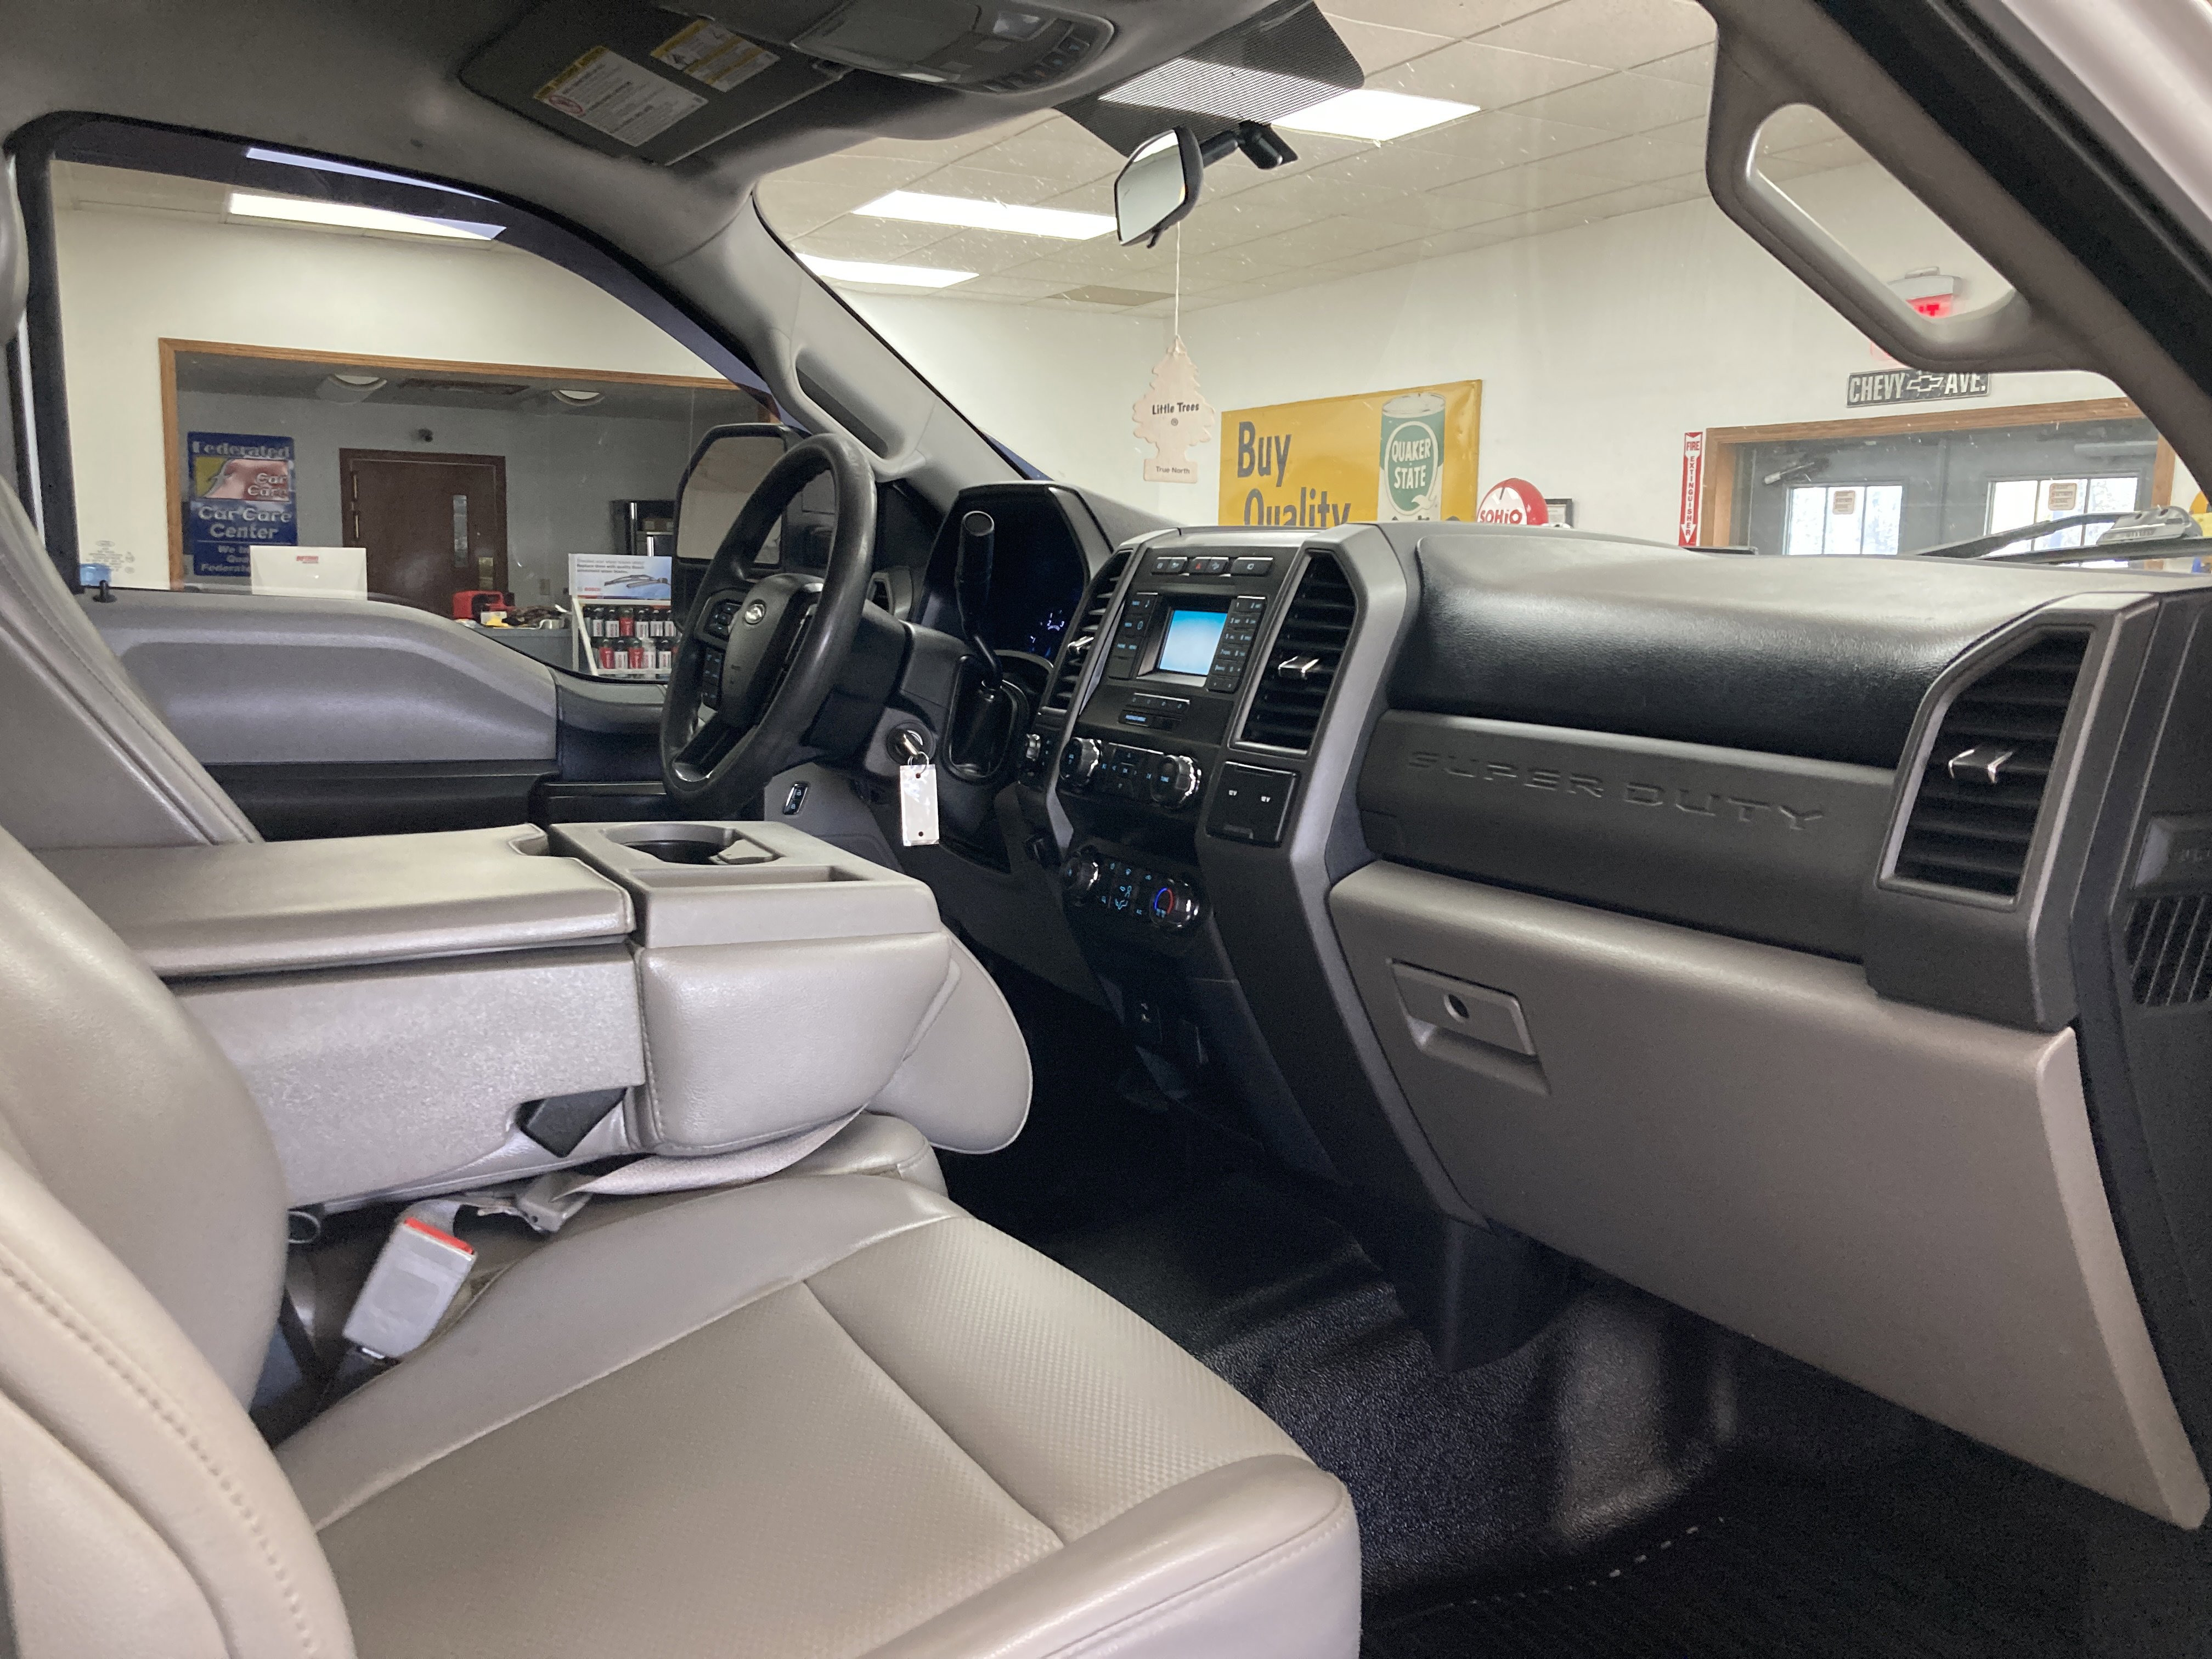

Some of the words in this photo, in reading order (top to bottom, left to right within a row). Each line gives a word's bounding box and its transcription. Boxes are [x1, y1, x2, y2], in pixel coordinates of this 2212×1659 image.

[1849, 373, 1905, 403] CHEVY
[1944, 373, 1986, 394] AVE.
[1152, 403, 1175, 415] Little
[1177, 402, 1200, 413] Trees
[192, 441, 290, 458] Federated
[1237, 421, 1292, 487] Buy
[1391, 438, 1431, 463] QUAKER
[1686, 441, 1700, 452] FIRE
[256, 473, 287, 486] Car
[1393, 465, 1426, 489] STATE
[247, 485, 287, 496] Care
[1685, 456, 1695, 536] EXTINGUISHER
[198, 506, 240, 521] Car
[242, 507, 293, 523] Care
[209, 523, 279, 539] Center
[1408, 752, 1605, 798] SUPER
[1623, 781, 1824, 831] DUTY
